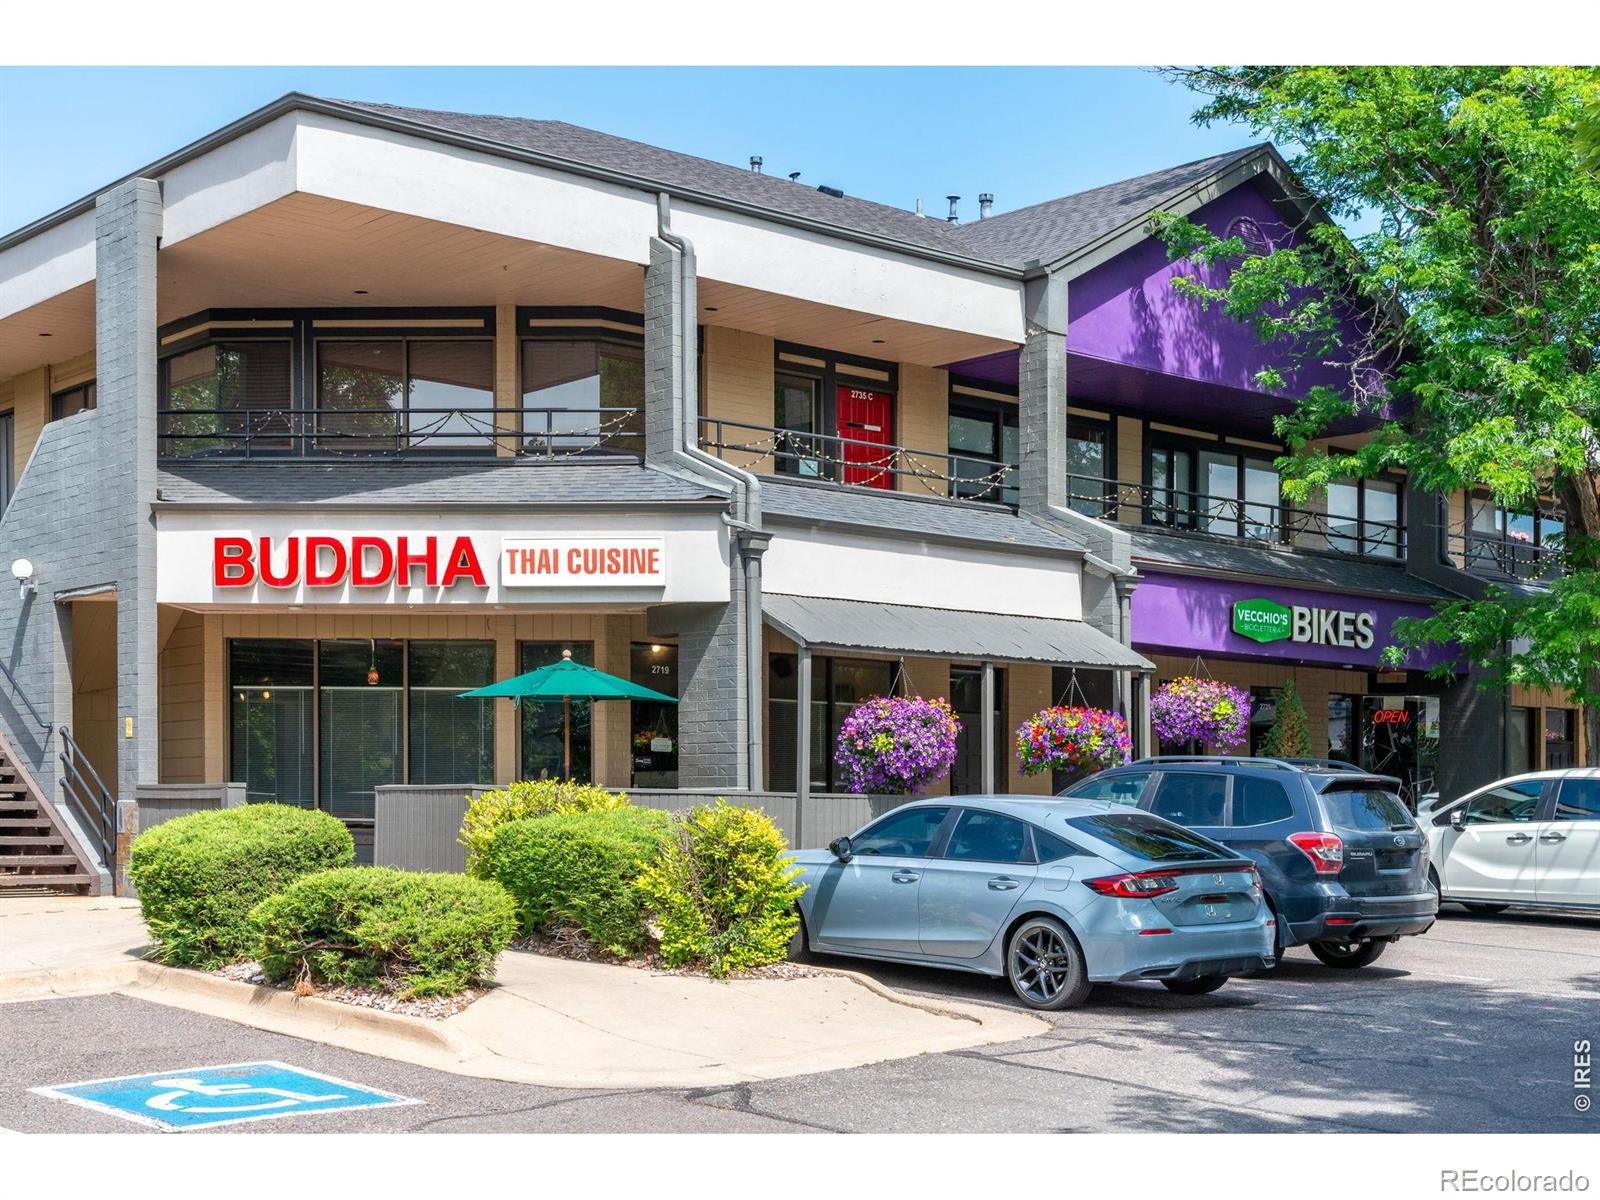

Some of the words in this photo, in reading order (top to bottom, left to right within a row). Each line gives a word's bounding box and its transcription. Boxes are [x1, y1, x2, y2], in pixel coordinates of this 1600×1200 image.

[851, 390, 867, 400] 2735
[867, 392, 874, 401] C
[213, 536, 488, 588] BUDDHA
[506, 548, 560, 575] THAI
[567, 548, 660, 575] CUISINE
[1237, 608, 1288, 626] VECCHIO'S
[1292, 605, 1374, 650] BIKES
[651, 665, 670, 675] 2719
[1374, 710, 1409, 724] OPEN
